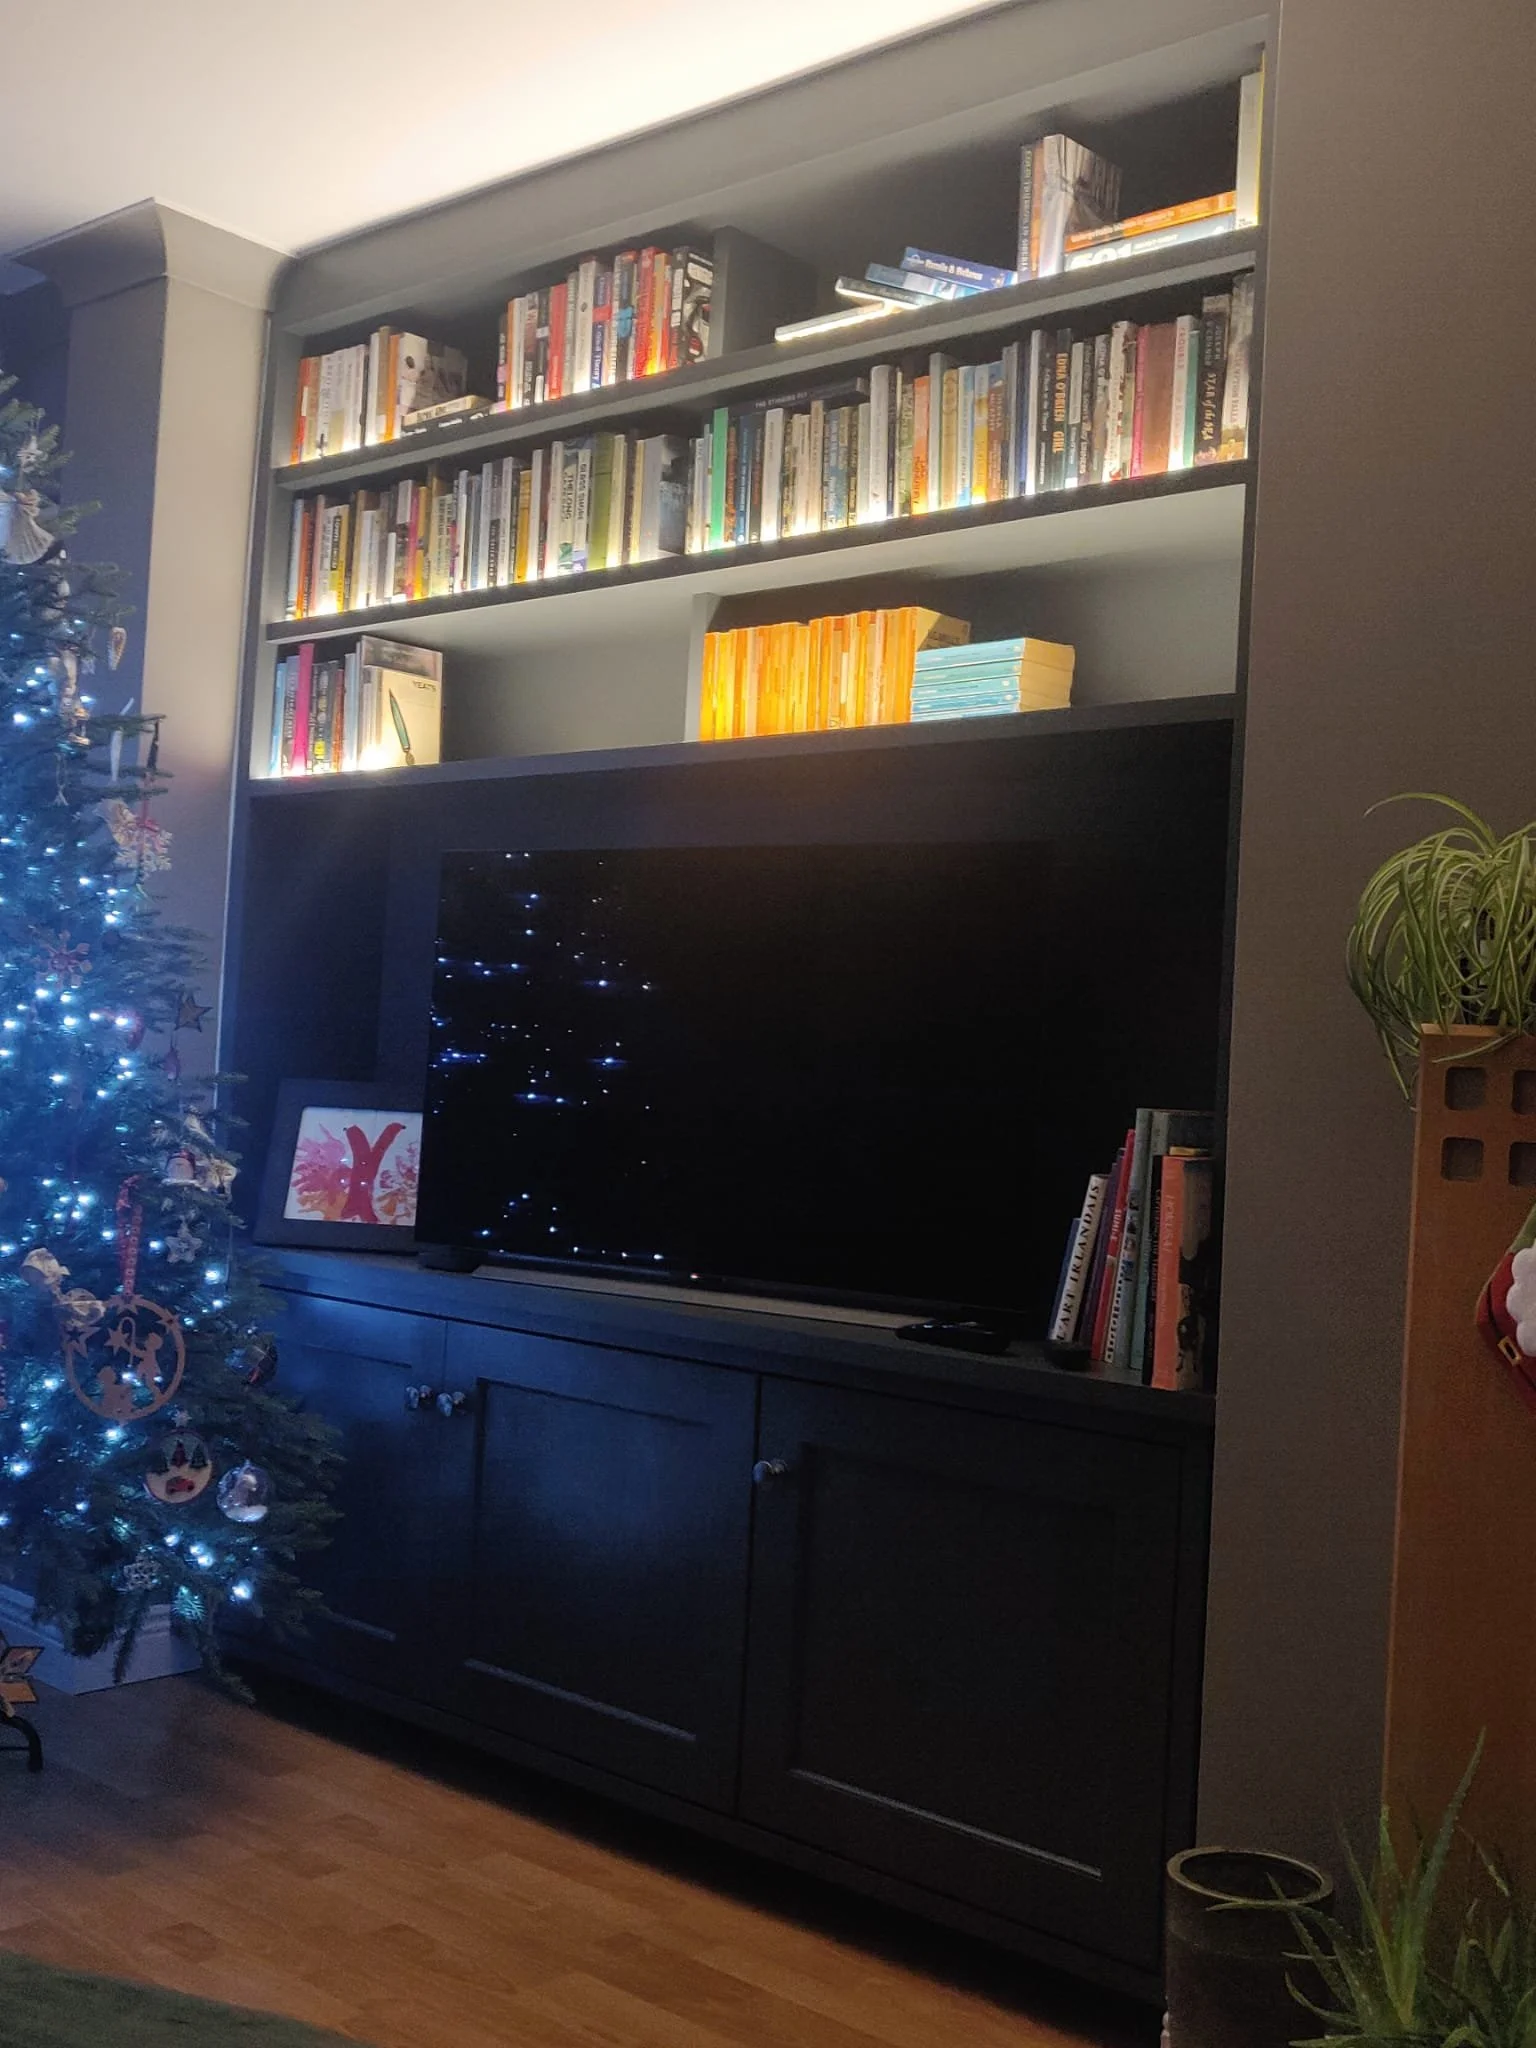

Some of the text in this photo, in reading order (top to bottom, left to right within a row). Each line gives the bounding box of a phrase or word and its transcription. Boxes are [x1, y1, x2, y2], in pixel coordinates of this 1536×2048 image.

[1071, 243, 1131, 270] 501
[1056, 353, 1067, 380] EDNA
[1205, 372, 1217, 397] STAR
[1052, 431, 1064, 453] GIRL
[1202, 420, 1215, 441] SEA
[565, 491, 573, 519] LONG
[1163, 1194, 1175, 1254] HOKUSAI
[1056, 1184, 1100, 1341] L'ART IRLANDAIS
